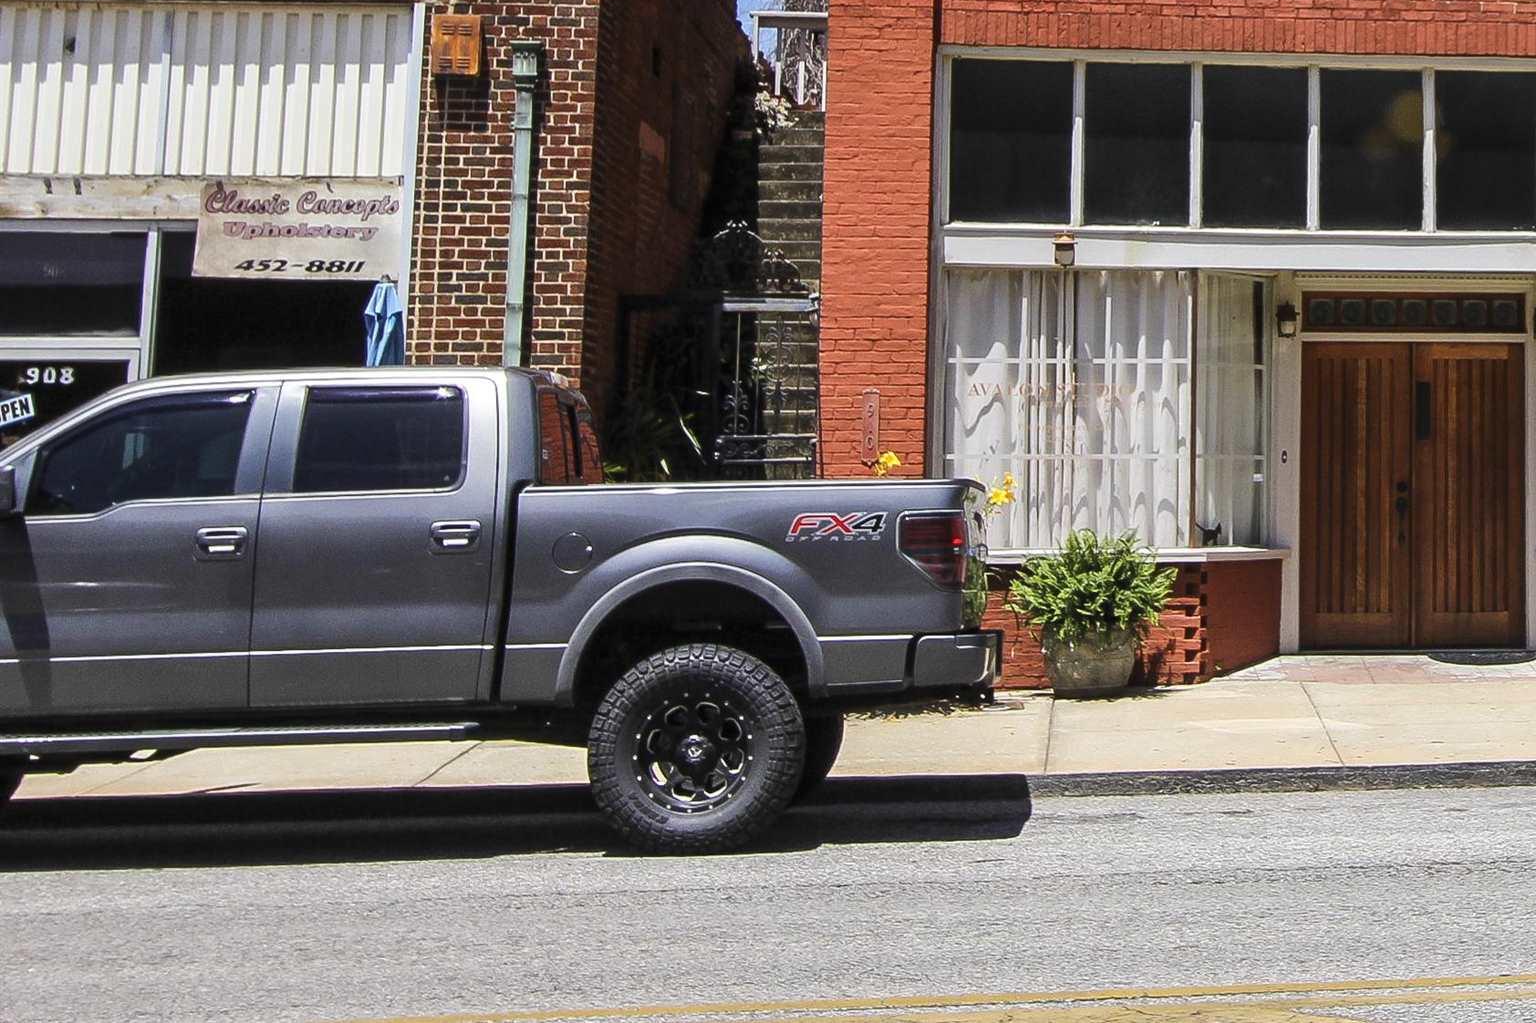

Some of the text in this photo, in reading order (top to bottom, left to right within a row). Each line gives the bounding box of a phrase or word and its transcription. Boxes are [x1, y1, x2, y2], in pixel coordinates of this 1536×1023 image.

[205, 189, 400, 221] Classic Concepts
[223, 221, 379, 241] Upholstery
[234, 259, 366, 273] 452-8811
[26, 367, 74, 384] 908
[0, 398, 30, 422] PEN
[788, 512, 889, 536] FX4
[830, 534, 881, 542] ROAD
